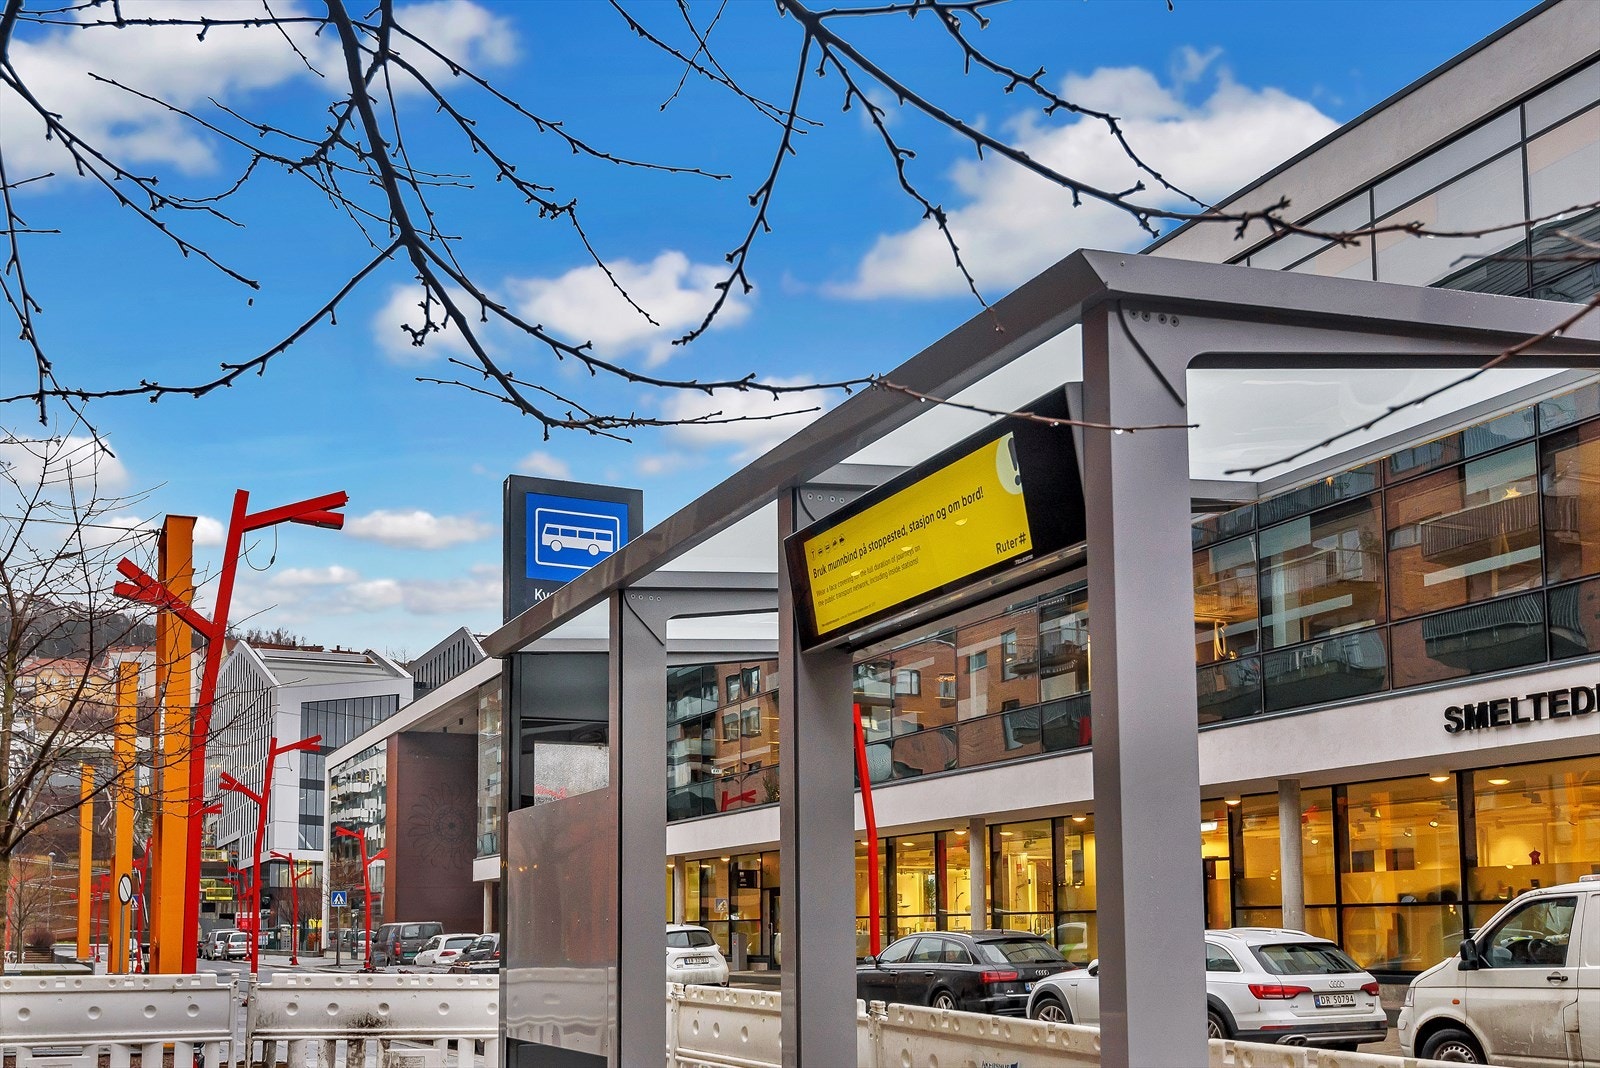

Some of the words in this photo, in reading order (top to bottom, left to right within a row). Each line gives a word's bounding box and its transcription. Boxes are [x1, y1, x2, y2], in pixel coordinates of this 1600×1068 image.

[812, 565, 828, 579] Bruk
[827, 548, 858, 572] munnbind
[858, 542, 868, 559] på
[868, 524, 909, 552] stoppested,
[908, 511, 935, 533] stasjon
[936, 507, 947, 520] og
[947, 499, 961, 514] om
[961, 486, 984, 507] bord!
[534, 588, 555, 600] Kv
